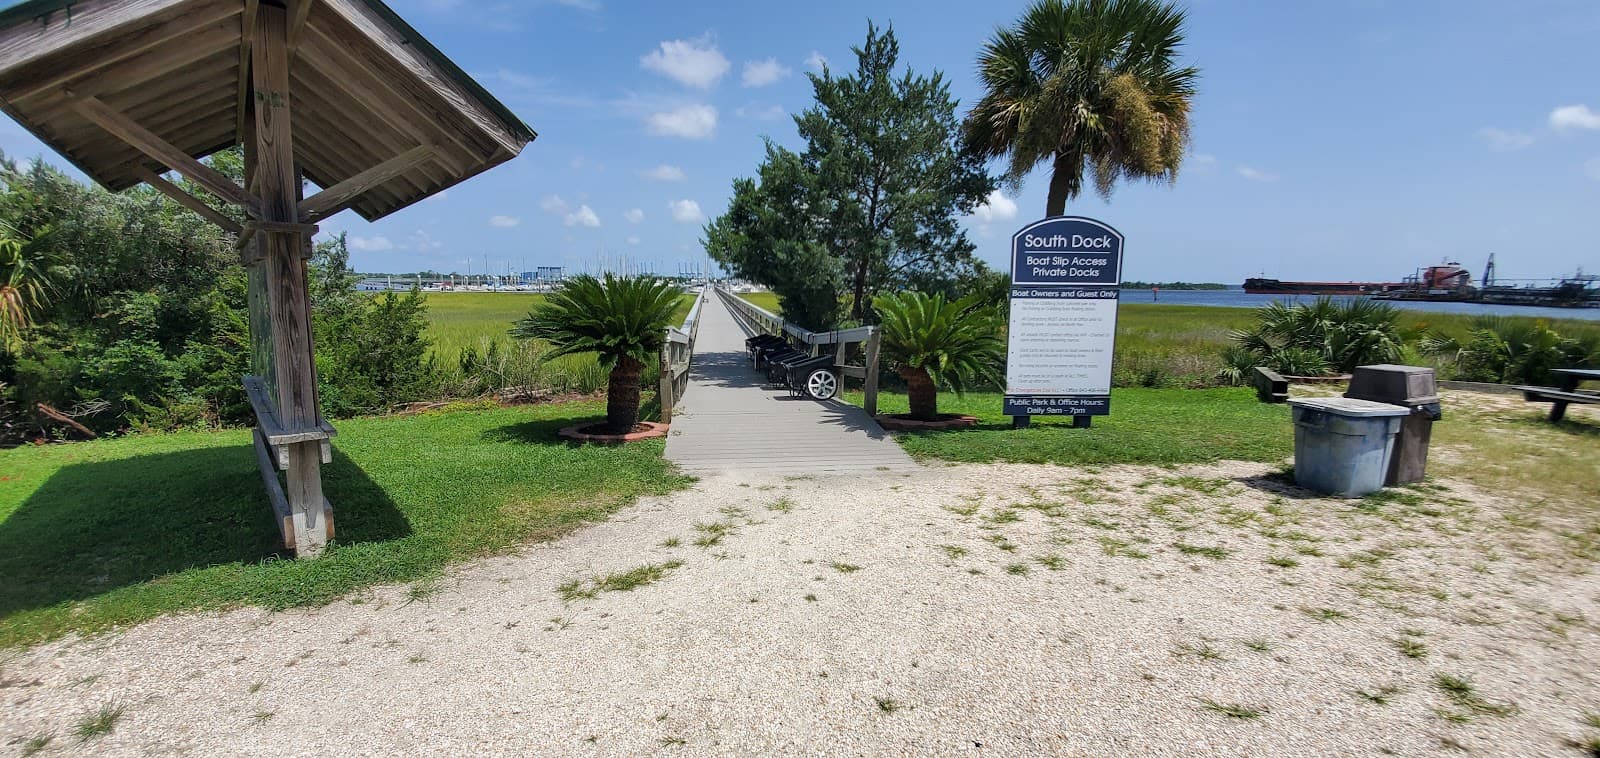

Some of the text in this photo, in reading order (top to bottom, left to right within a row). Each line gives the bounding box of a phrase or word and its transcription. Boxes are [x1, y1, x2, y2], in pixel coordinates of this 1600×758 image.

[1024, 234, 1111, 248] South Dock
[1026, 256, 1107, 267] Boat Slip Access
[1032, 267, 1100, 277] Private Docks
[1012, 289, 1118, 299] Boat Owners and Guest Only
[1070, 407, 1086, 415] 7pm
